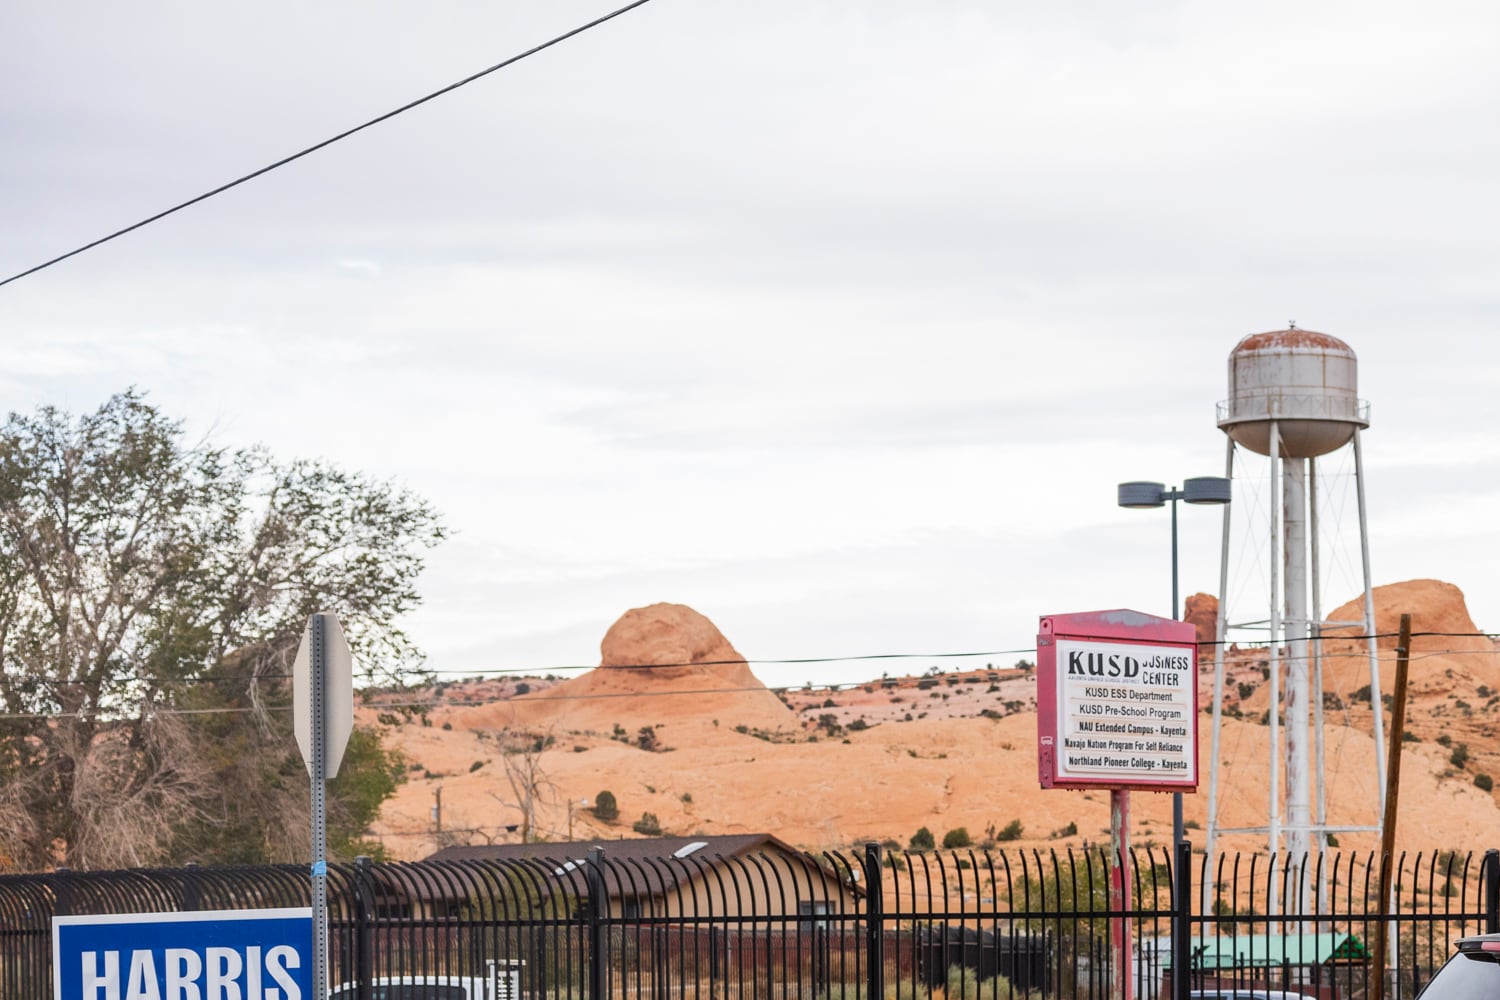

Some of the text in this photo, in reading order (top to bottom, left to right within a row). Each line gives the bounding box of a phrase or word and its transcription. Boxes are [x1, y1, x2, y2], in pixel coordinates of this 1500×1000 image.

[1068, 651, 1139, 677] KUSD
[1143, 671, 1179, 686] CENTER
[1085, 687, 1173, 702] KUSD ESS Department
[1079, 704, 1181, 720] KUSD Pre-School Program
[1079, 721, 1093, 731] NAU
[1095, 722, 1126, 733] Extended
[1127, 724, 1154, 735] Campus
[1160, 725, 1187, 737] Kayenta
[1064, 738, 1183, 752] Navajo Nation Program For Self Reliance
[1069, 756, 1102, 766] Northland
[1104, 757, 1129, 767] Pioneer
[1131, 757, 1155, 770] College
[1161, 759, 1188, 771] Kayenta
